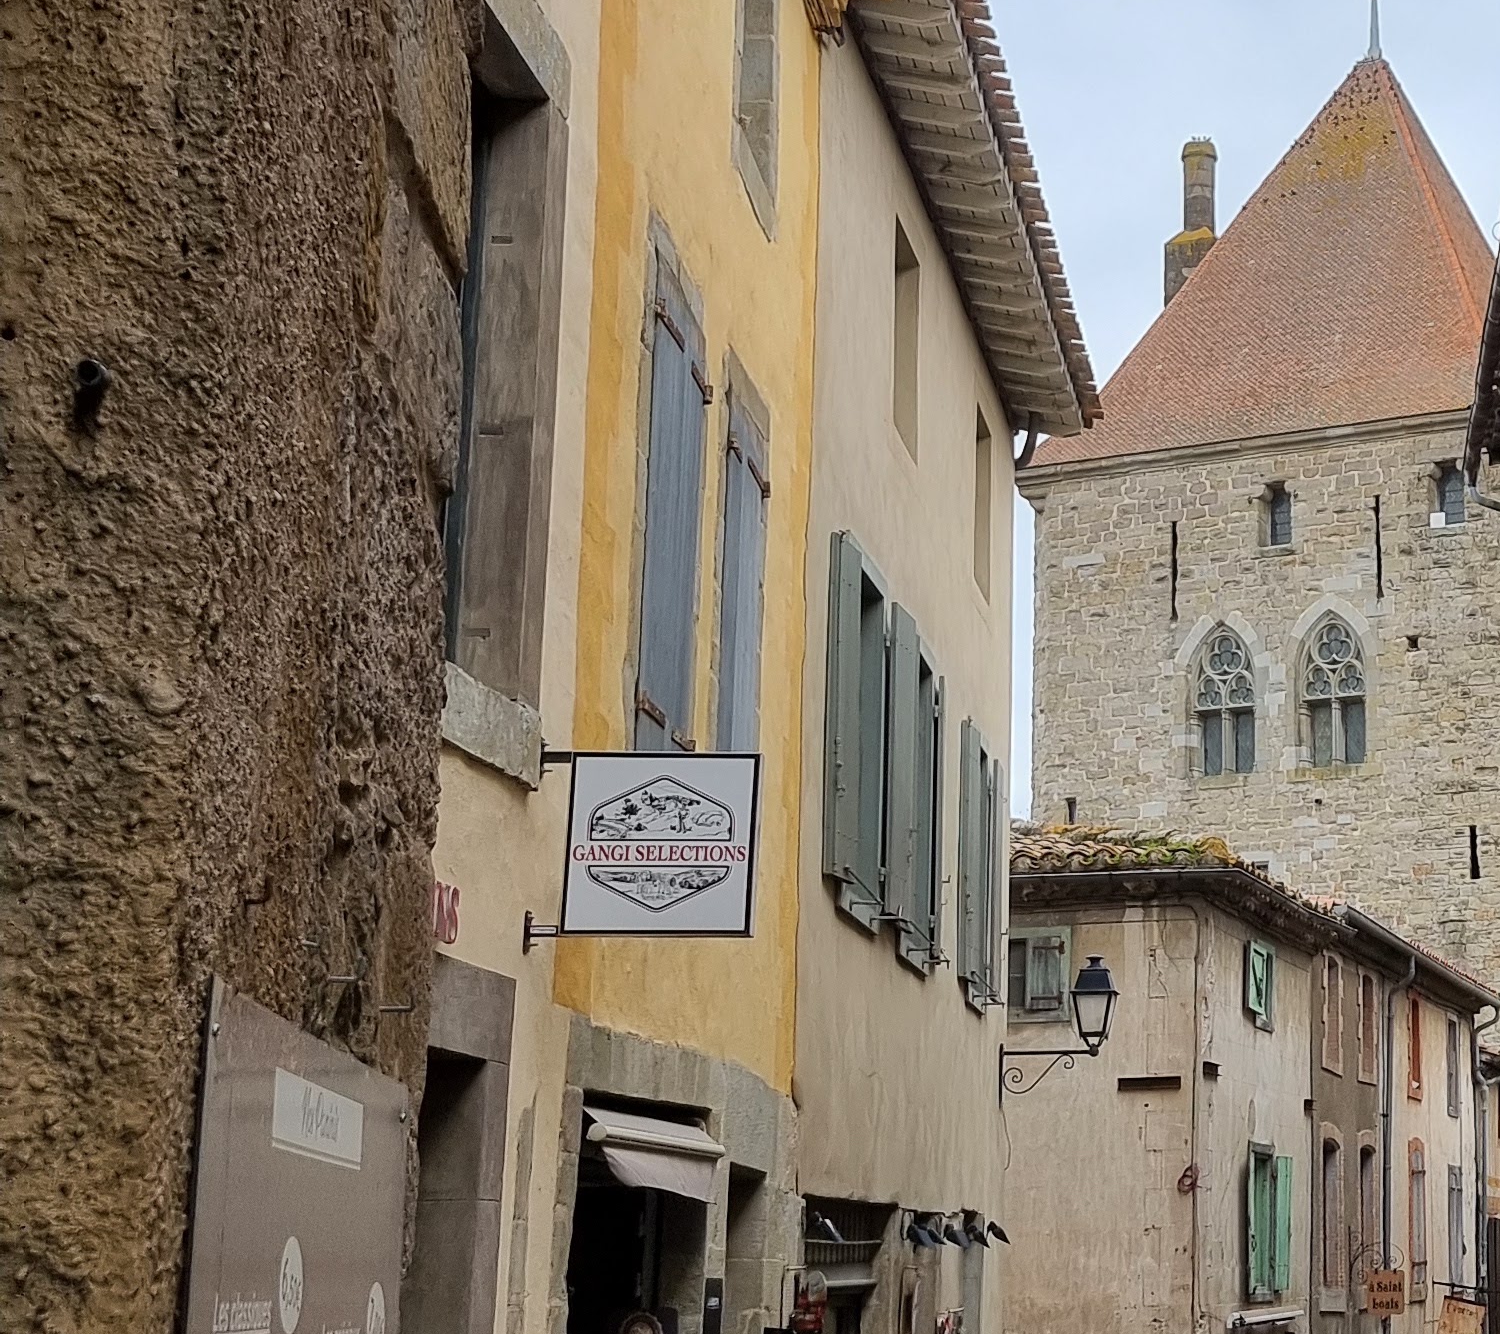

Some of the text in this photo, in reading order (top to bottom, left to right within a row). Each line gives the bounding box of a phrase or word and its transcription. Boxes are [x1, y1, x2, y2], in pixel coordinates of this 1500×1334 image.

[572, 844, 747, 862] GANGI SELECTIONS
[1376, 1281, 1403, 1292] Saint
[1372, 1297, 1400, 1310] Louis
[212, 1291, 272, 1333] Les classiques
